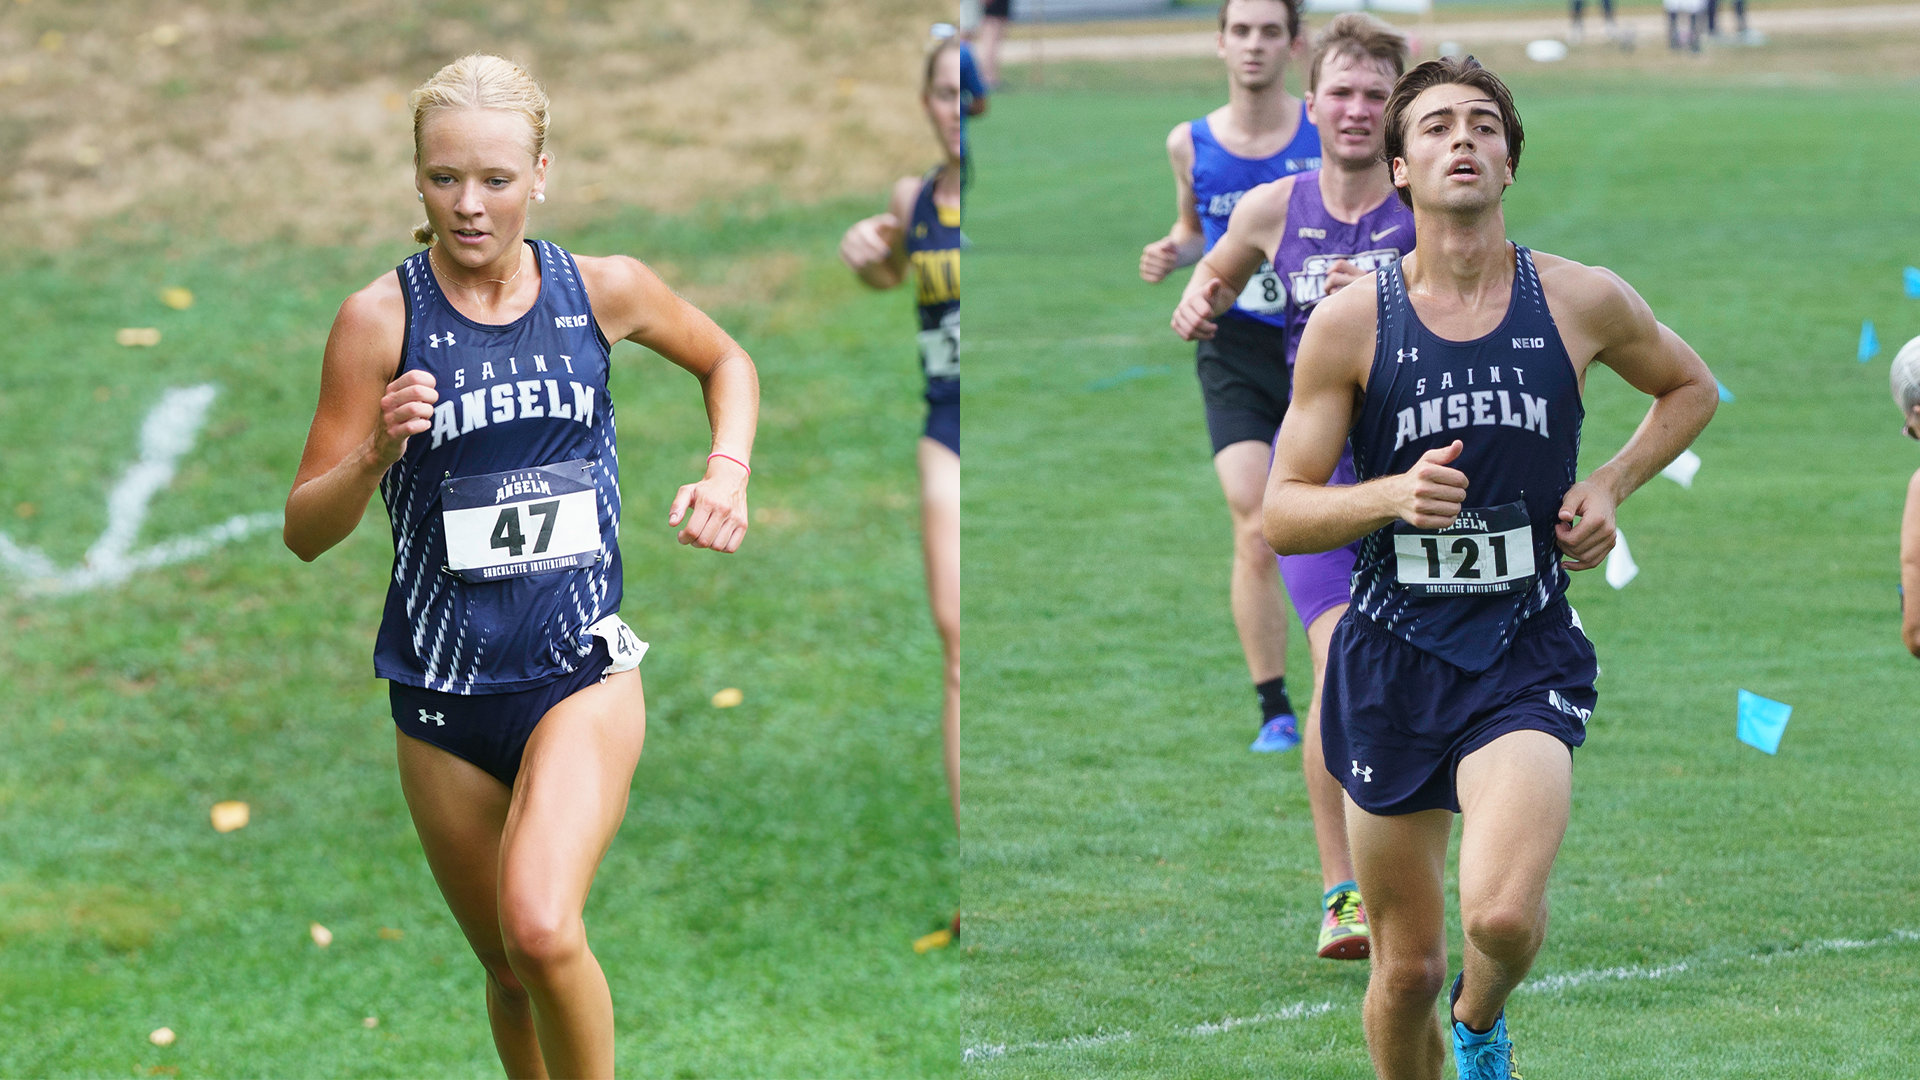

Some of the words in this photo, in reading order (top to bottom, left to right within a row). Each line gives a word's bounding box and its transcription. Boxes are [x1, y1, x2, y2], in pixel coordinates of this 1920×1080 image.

[1308, 253, 1396, 275] SNT
[1262, 278, 1278, 302] 8
[555, 314, 588, 328] NE10
[1512, 337, 1545, 349] NE10
[455, 354, 574, 389] SAINT
[1416, 366, 1524, 396] SAINT
[431, 379, 596, 450] ANSELM
[1394, 390, 1550, 451] ANSELM
[495, 480, 553, 504] ANSELM
[503, 472, 541, 486] SAINT
[490, 500, 561, 557] 47
[530, 556, 578, 572] INVITATIONAL
[1421, 535, 1509, 579] 121
[1466, 582, 1511, 593] INVITATIONAL
[617, 624, 640, 656] 47
[1549, 690, 1592, 726] NE10
